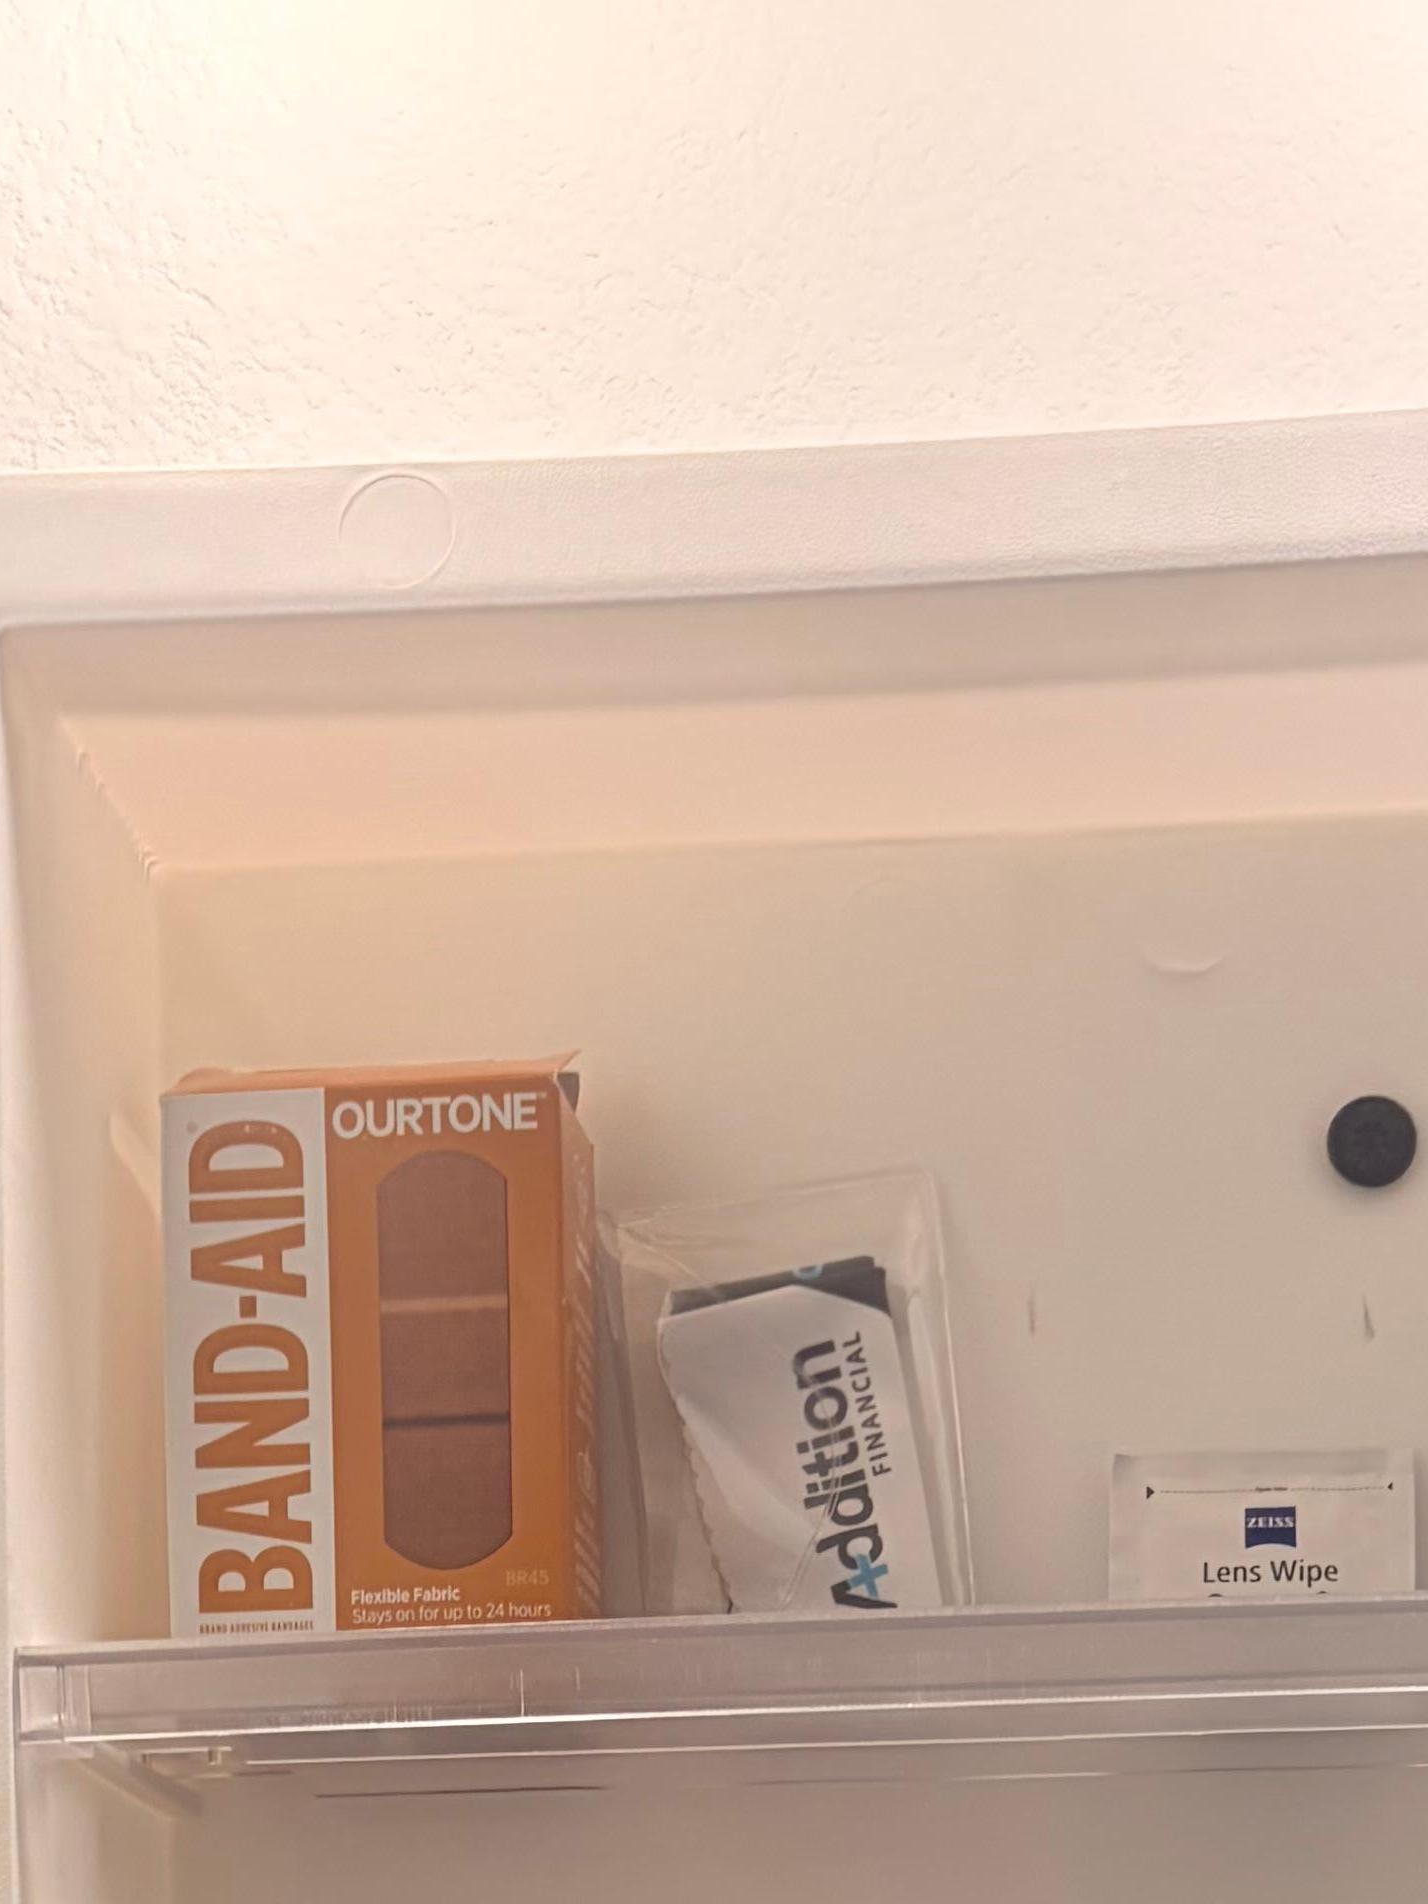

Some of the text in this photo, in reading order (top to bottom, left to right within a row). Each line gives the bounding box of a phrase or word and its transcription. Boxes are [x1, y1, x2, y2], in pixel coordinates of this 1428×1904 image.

[332, 1092, 538, 1140] OURTONE
[188, 1120, 314, 1614] BAND-AID
[841, 1330, 892, 1477] FINANCIAL
[792, 1339, 897, 1610] Addition
[1247, 1516, 1294, 1528] ZEISS
[506, 1569, 550, 1586] BR45
[1203, 1559, 1339, 1587] Lens Wipe
[350, 1585, 461, 1606] Flexible Fabric
[352, 1600, 552, 1624] Stays on for up to 24 hours
